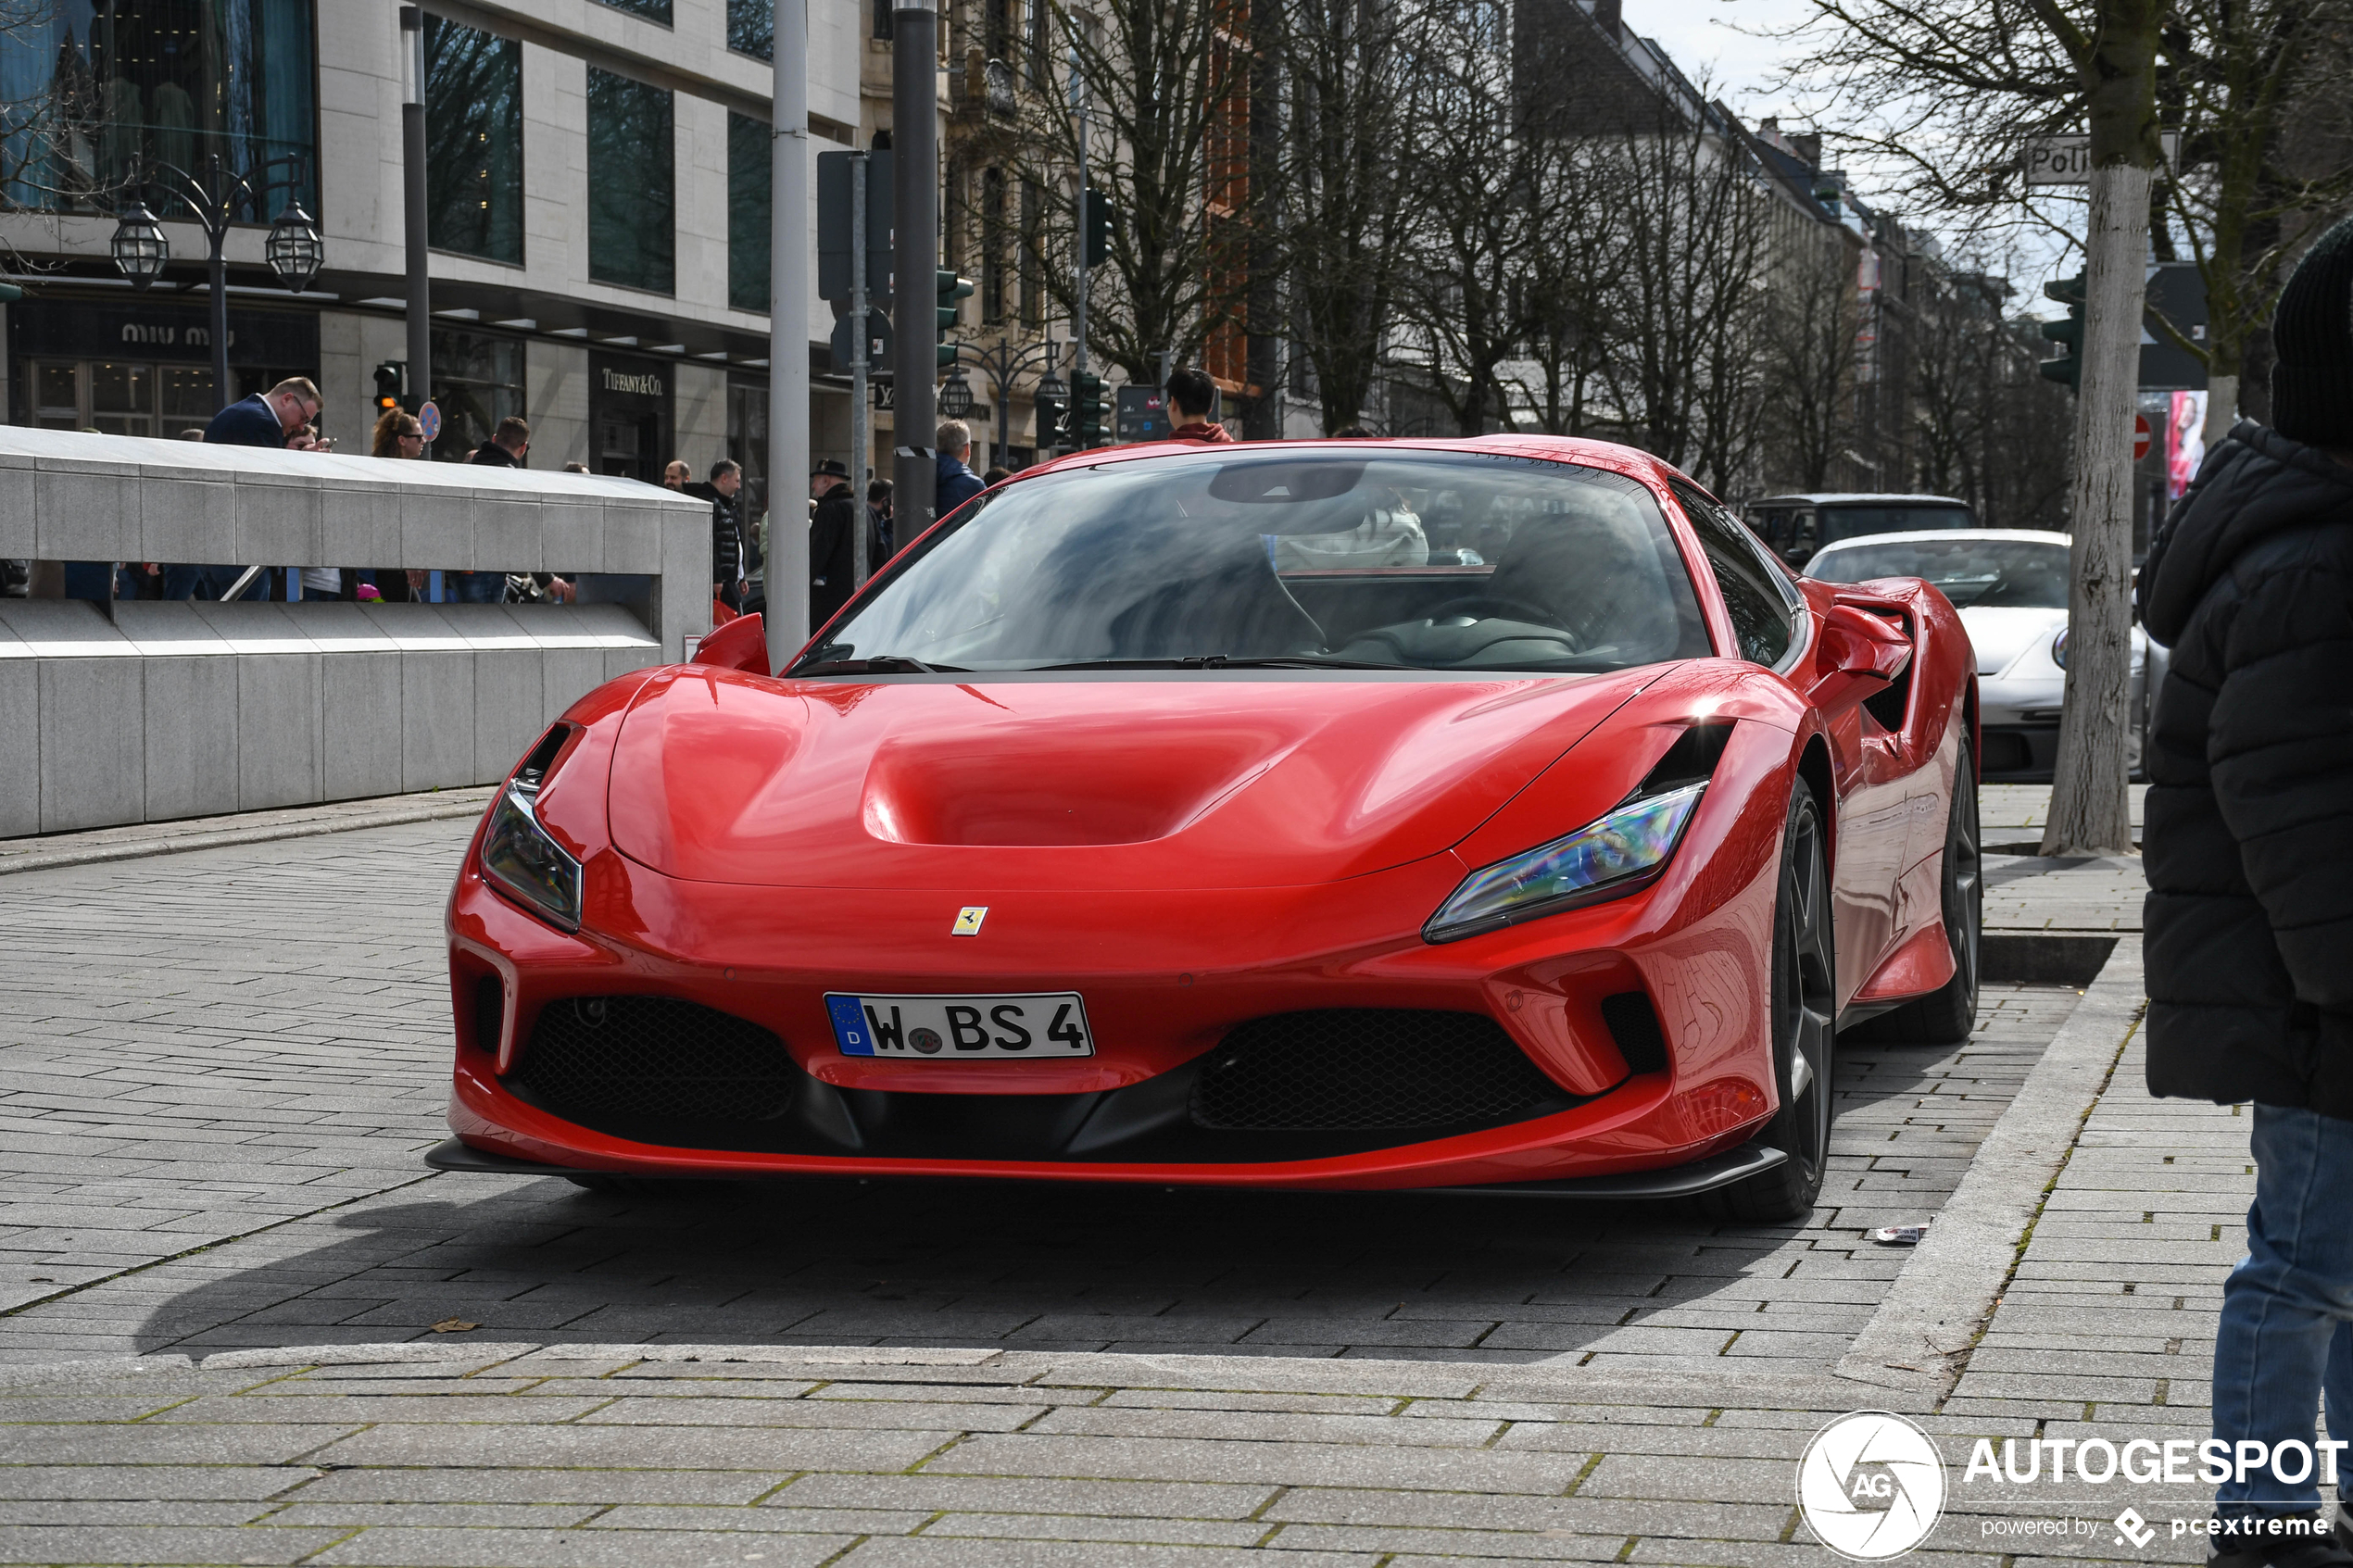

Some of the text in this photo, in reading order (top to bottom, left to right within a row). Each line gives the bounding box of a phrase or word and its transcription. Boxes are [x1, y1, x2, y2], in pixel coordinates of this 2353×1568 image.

[2032, 146, 2088, 173] Poli
[847, 1031, 861, 1045] D
[863, 1005, 904, 1050] W
[945, 1004, 1032, 1051] BS
[1047, 1003, 1084, 1049] 4
